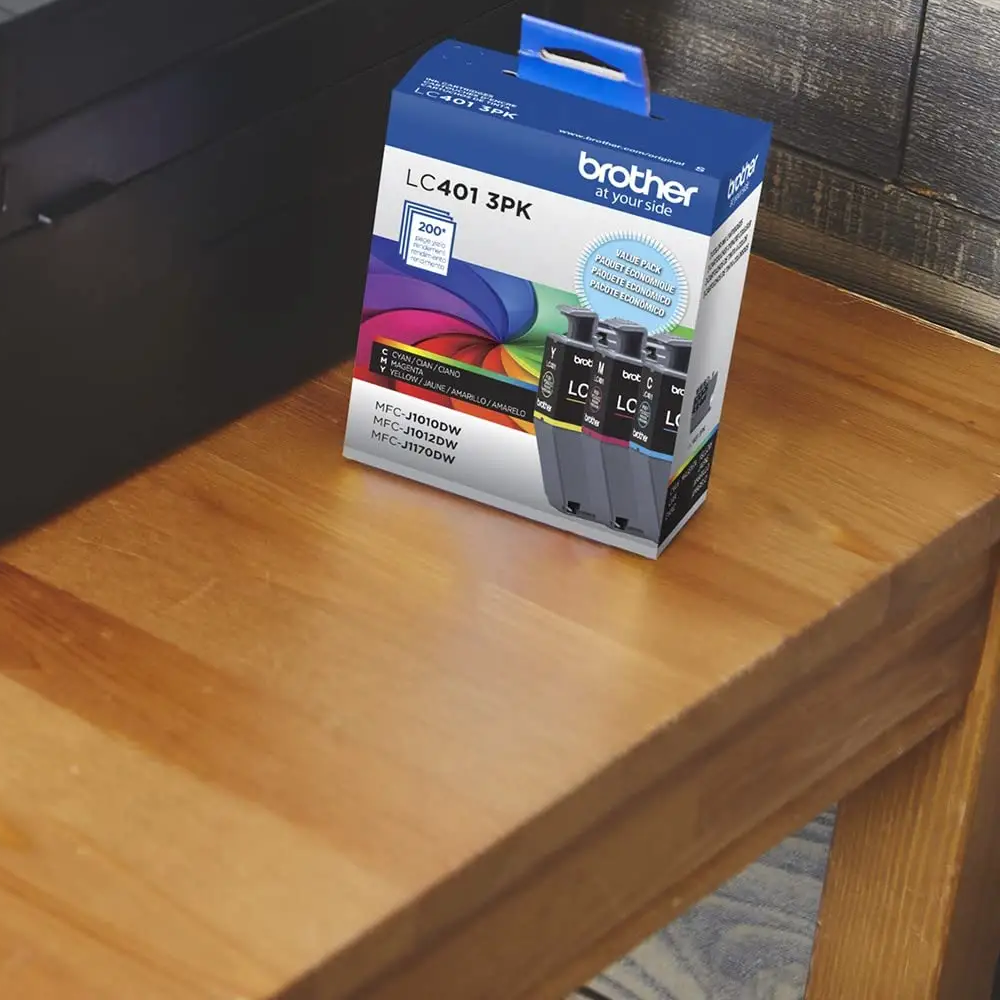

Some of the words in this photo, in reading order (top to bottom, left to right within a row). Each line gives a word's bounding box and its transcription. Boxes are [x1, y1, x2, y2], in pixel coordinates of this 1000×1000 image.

[413, 87, 475, 109] LC401
[478, 104, 519, 120] 3PK
[406, 168, 479, 205] LC401
[485, 191, 534, 221] 3PK
[577, 150, 699, 208] brother
[594, 185, 609, 200] at
[611, 191, 644, 210] your
[644, 199, 673, 218] side
[591, 266, 625, 287] PAQUETE
[594, 254, 626, 273] PAQUET
[616, 248, 641, 266] VALUE
[640, 259, 662, 275] PACK
[589, 279, 620, 298] PACOTE
[390, 359, 424, 376] MAGENTA
[391, 350, 412, 364] CYAN
[416, 357, 434, 371] CIAN
[437, 364, 461, 379] CIANO
[389, 368, 420, 385] YELLOW
[422, 378, 447, 393] JAUNE
[450, 387, 488, 407] AMARILLO
[491, 400, 527, 419] AMARELO
[567, 379, 590, 399] LC
[616, 394, 638, 414] LC
[372, 414, 459, 451] MFC-J1012DW
[375, 400, 462, 437] MFC-J1010DW
[371, 429, 456, 465] MFC-J1170DW
